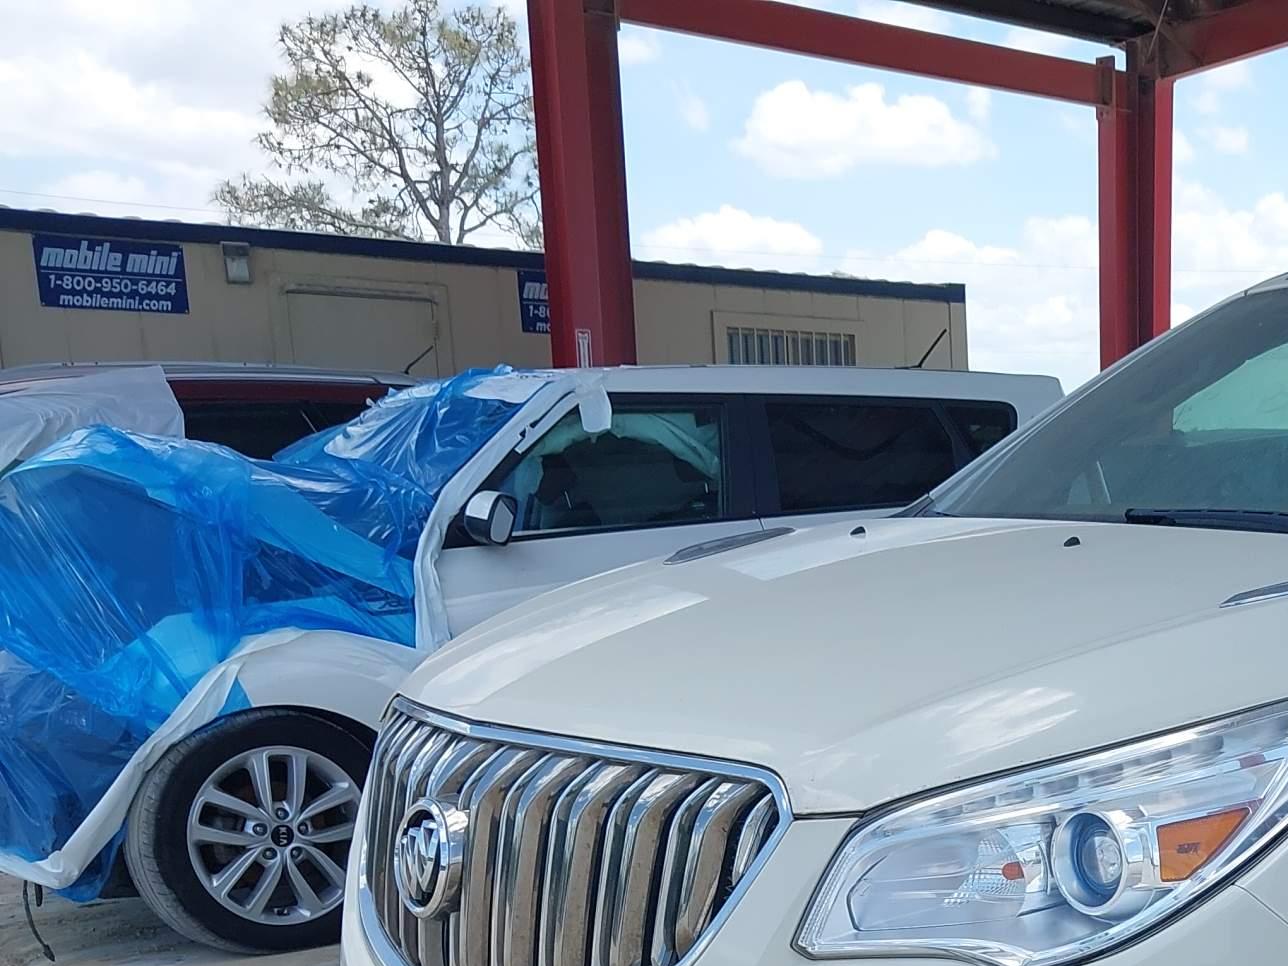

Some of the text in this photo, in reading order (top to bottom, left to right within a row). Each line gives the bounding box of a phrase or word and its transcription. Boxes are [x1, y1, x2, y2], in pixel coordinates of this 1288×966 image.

[41, 240, 178, 275] mobile mini
[49, 274, 176, 296] 1-800-950-6464
[59, 293, 172, 311] mobilemini.com
